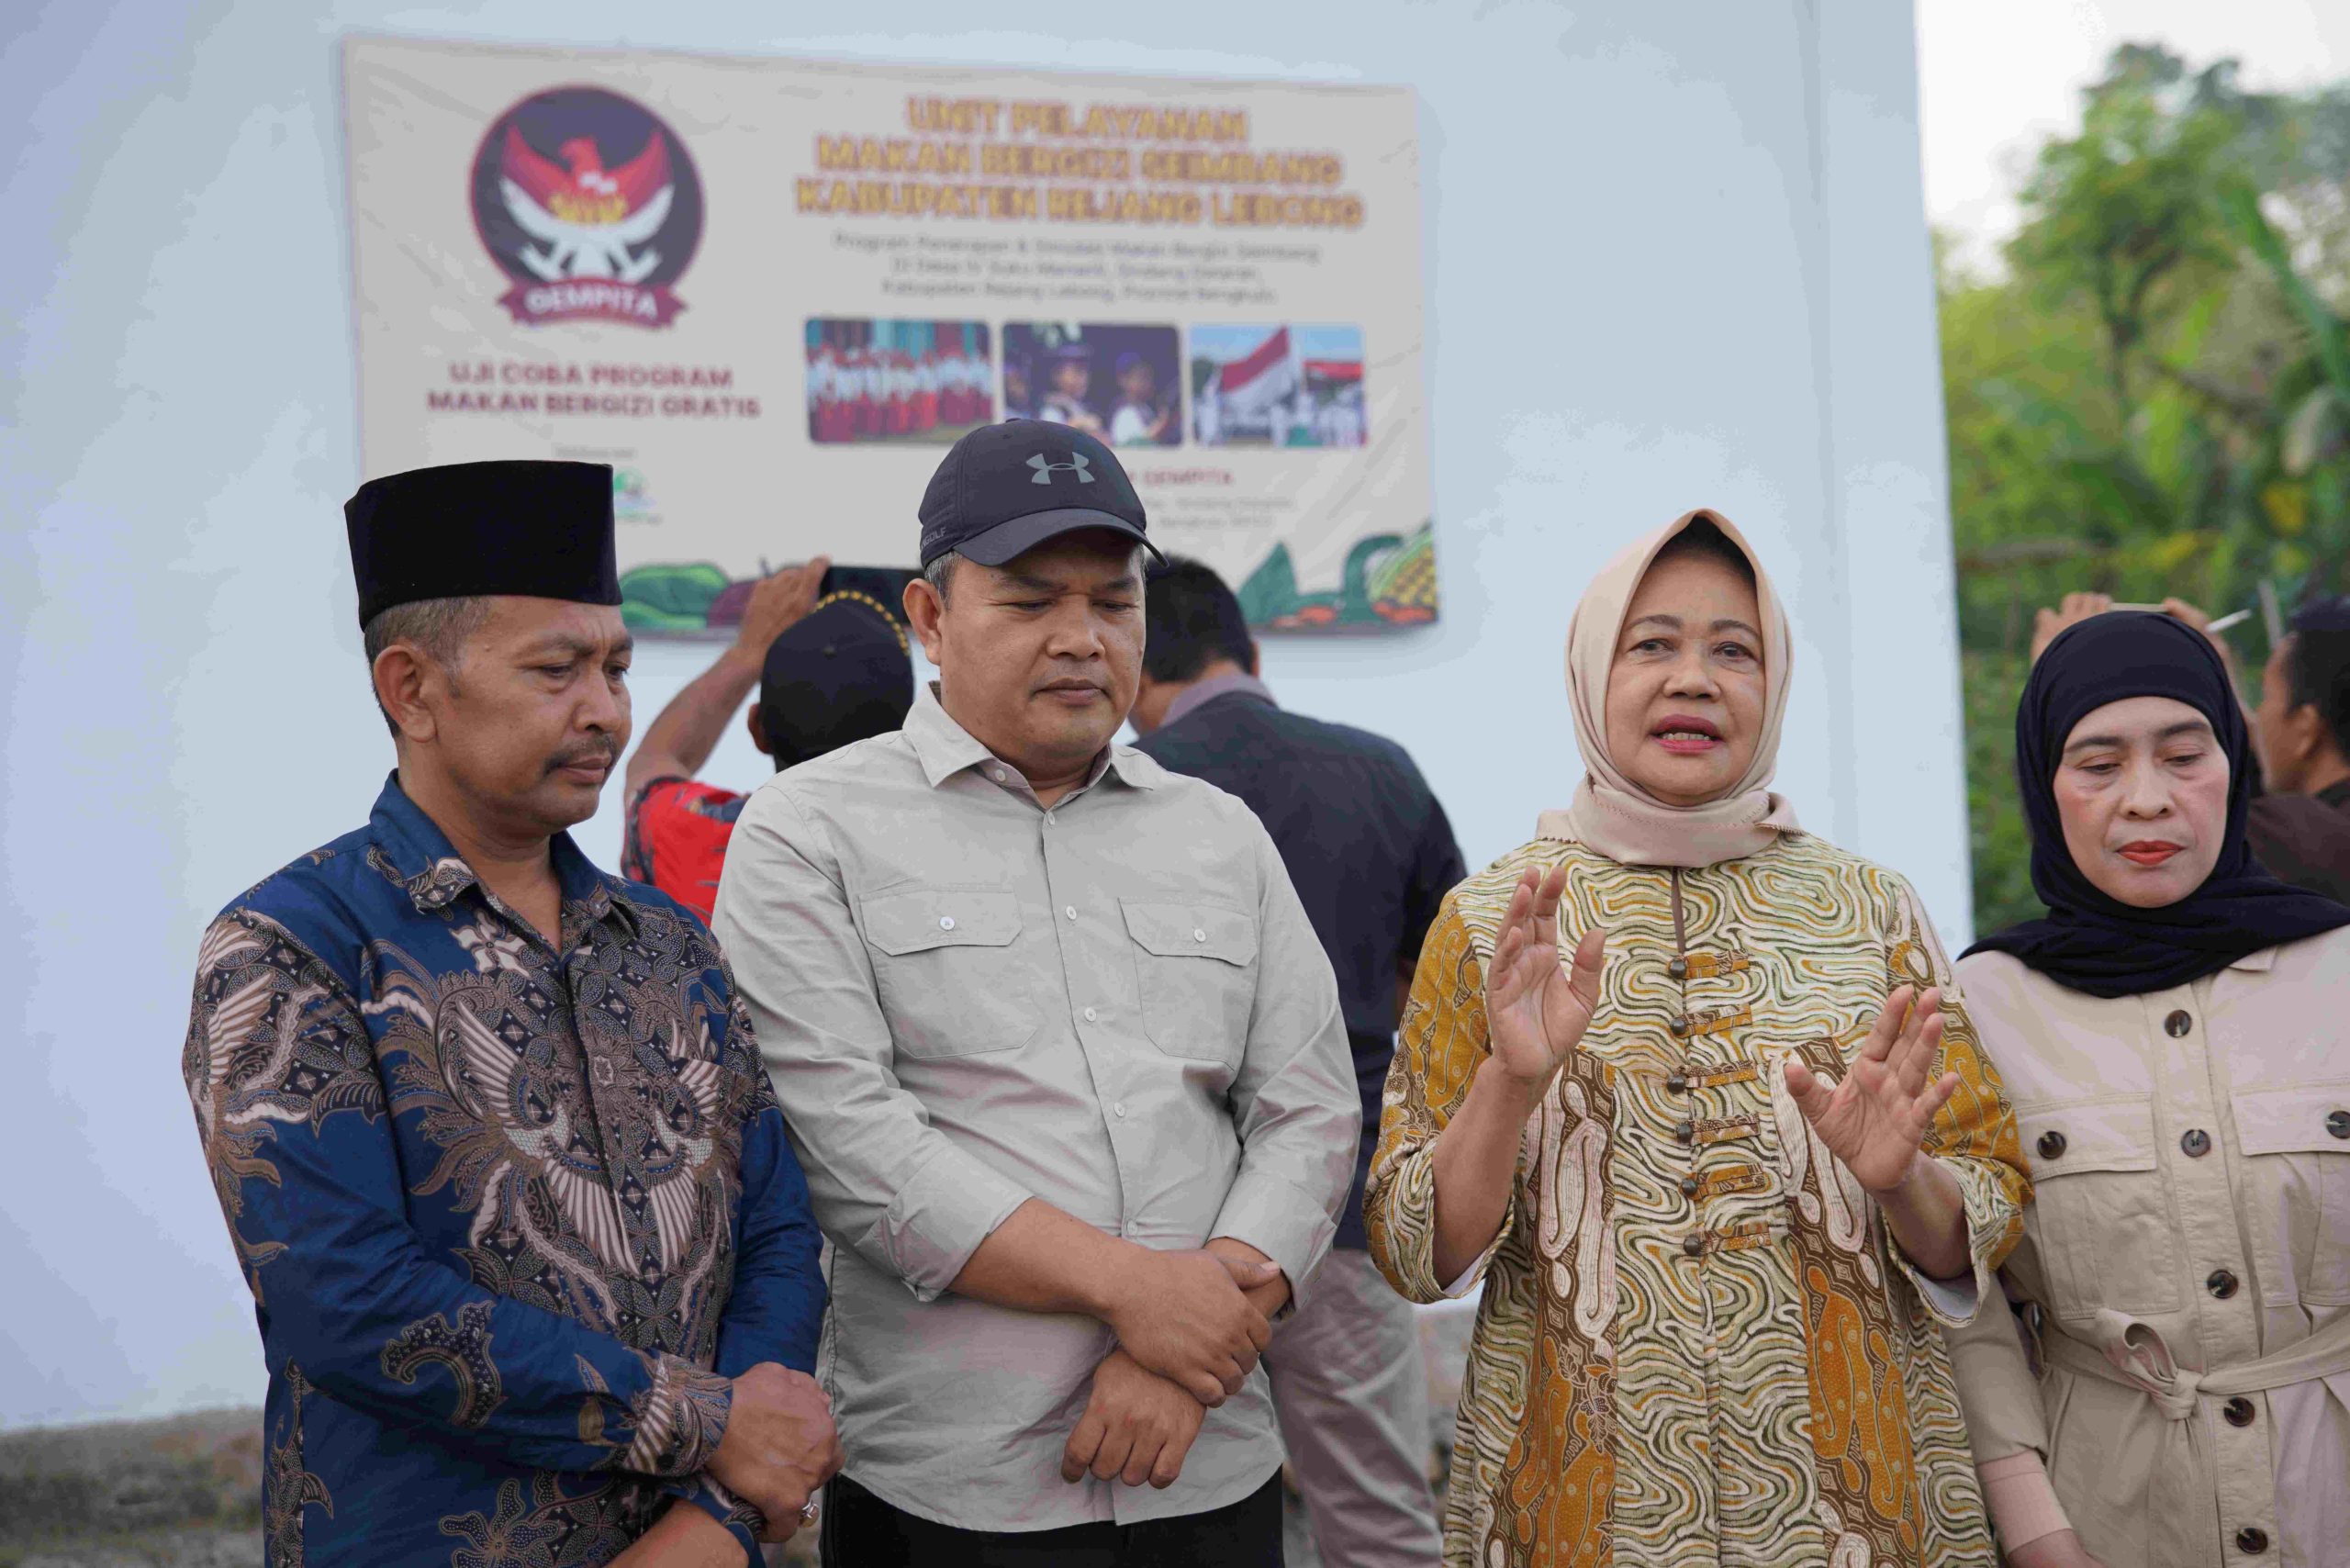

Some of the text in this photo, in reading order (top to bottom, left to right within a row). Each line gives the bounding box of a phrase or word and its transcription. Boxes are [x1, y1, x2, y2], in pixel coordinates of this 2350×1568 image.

[907, 97, 1248, 141] UNIT PELAYANAN
[816, 134, 971, 175] MAKAN
[980, 143, 1130, 181] BERGIZI
[797, 178, 1365, 230] KABUPATEN REJANG LEBONG
[523, 283, 659, 319] GEMPITA
[448, 361, 733, 388] UJI COBA PROGRAM
[427, 388, 761, 419] MAKAN BERGIZI GRATIS
